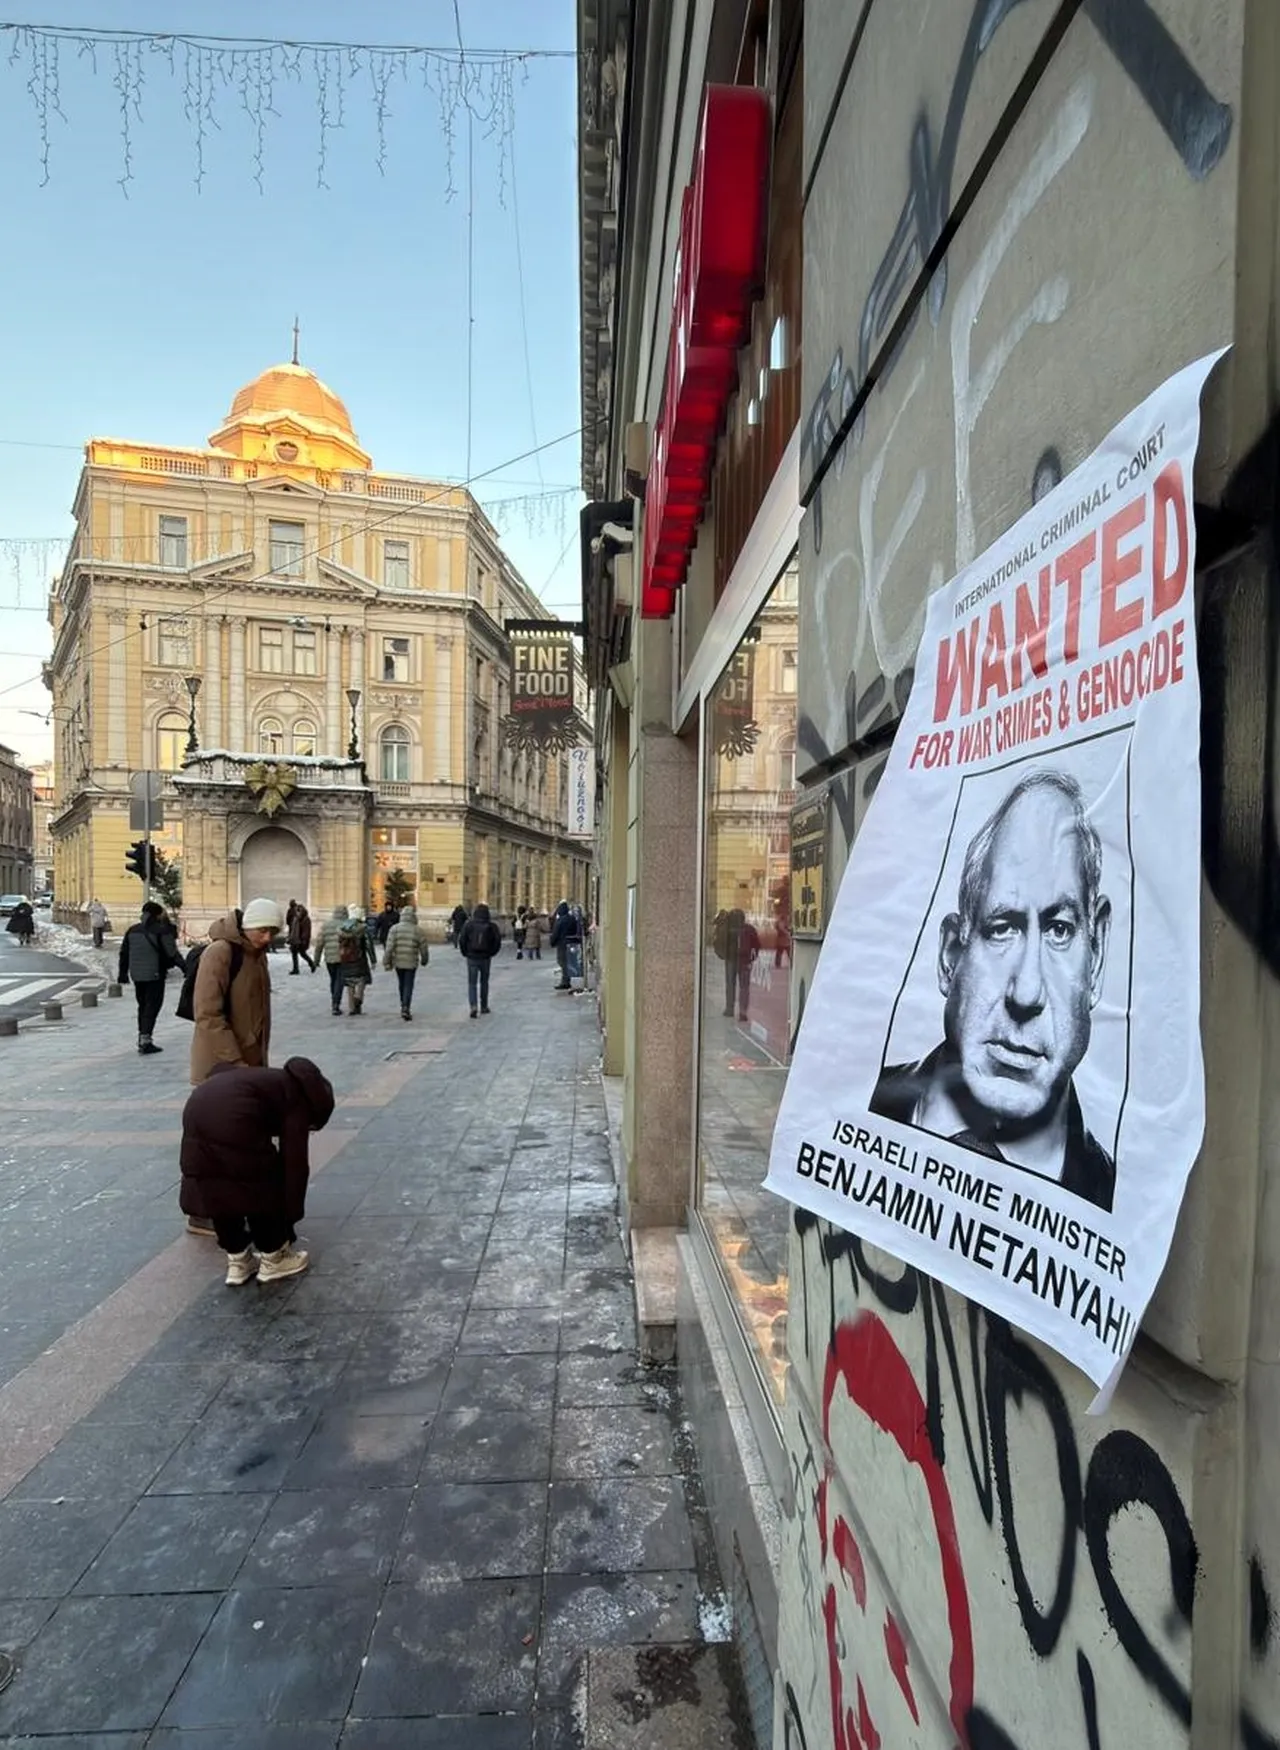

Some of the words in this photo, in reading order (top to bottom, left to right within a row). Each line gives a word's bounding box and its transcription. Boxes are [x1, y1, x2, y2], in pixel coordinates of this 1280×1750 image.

[933, 459, 1189, 723] WANTED
[954, 546, 1037, 619] INTERNATIONAL
[1040, 482, 1111, 550] CRIMINAL
[1116, 423, 1167, 490] COURT
[514, 646, 569, 671] FINE
[514, 672, 569, 695] FOOD
[908, 730, 955, 769] FOR
[957, 716, 992, 765] WAR
[995, 686, 1051, 753] CRIMES
[1058, 679, 1070, 730] &
[1077, 619, 1185, 724] GENOCIDE
[796, 1141, 944, 1241] BENJAMIN
[832, 1119, 918, 1174] ISRAELI
[922, 1156, 1003, 1212] PRIME
[1008, 1193, 1126, 1282] MINISTER
